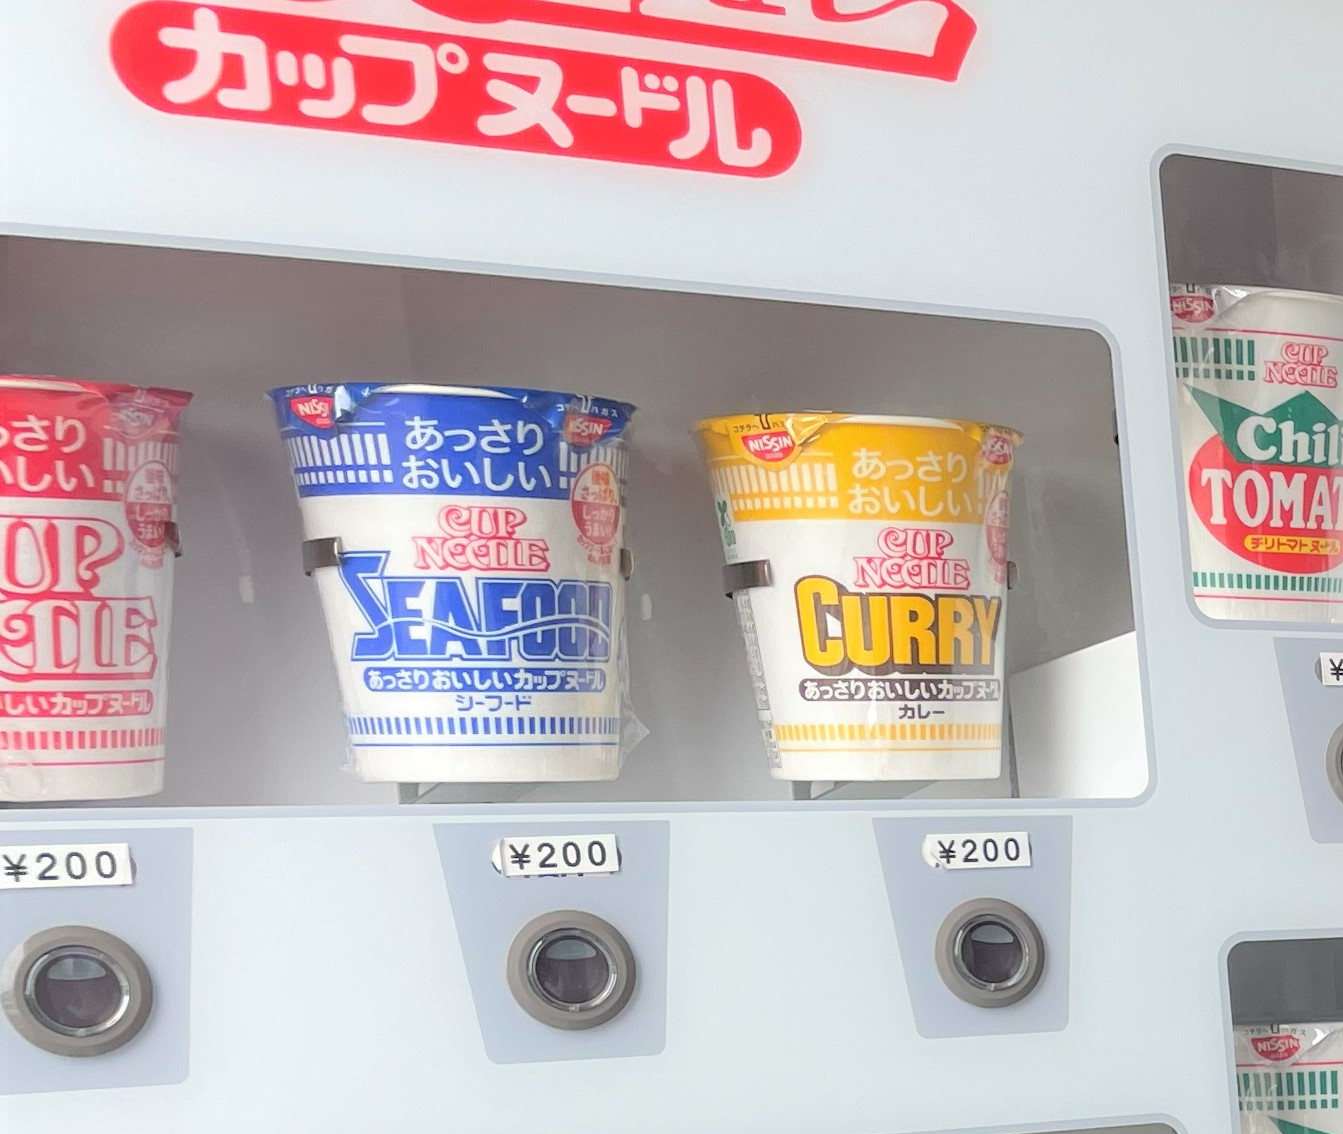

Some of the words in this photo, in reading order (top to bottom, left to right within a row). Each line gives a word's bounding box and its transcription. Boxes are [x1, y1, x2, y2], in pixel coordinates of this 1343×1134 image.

[157, 13, 771, 169] カップヌードル
[1280, 343, 1329, 366] CUP
[1263, 360, 1338, 388] NOODLE
[404, 415, 545, 456] あっさり
[748, 432, 792, 452] NISSIN
[401, 455, 551, 492] おいしい
[852, 447, 968, 483] あっさり
[847, 484, 974, 516] おいしい
[437, 504, 528, 539] CUP
[412, 536, 550, 573] NOODLE
[878, 527, 954, 559] CUP
[853, 556, 971, 590] NOODLE
[339, 550, 613, 662] SEAFOOD
[794, 574, 1002, 677] CURRY
[368, 668, 603, 691] あっさりおいしいカップヌードル
[455, 694, 532, 712] シーフード
[898, 704, 946, 719] カレー
[3, 848, 119, 885] ¥200
[507, 837, 610, 871] ¥200
[937, 835, 1023, 868] ¥200
